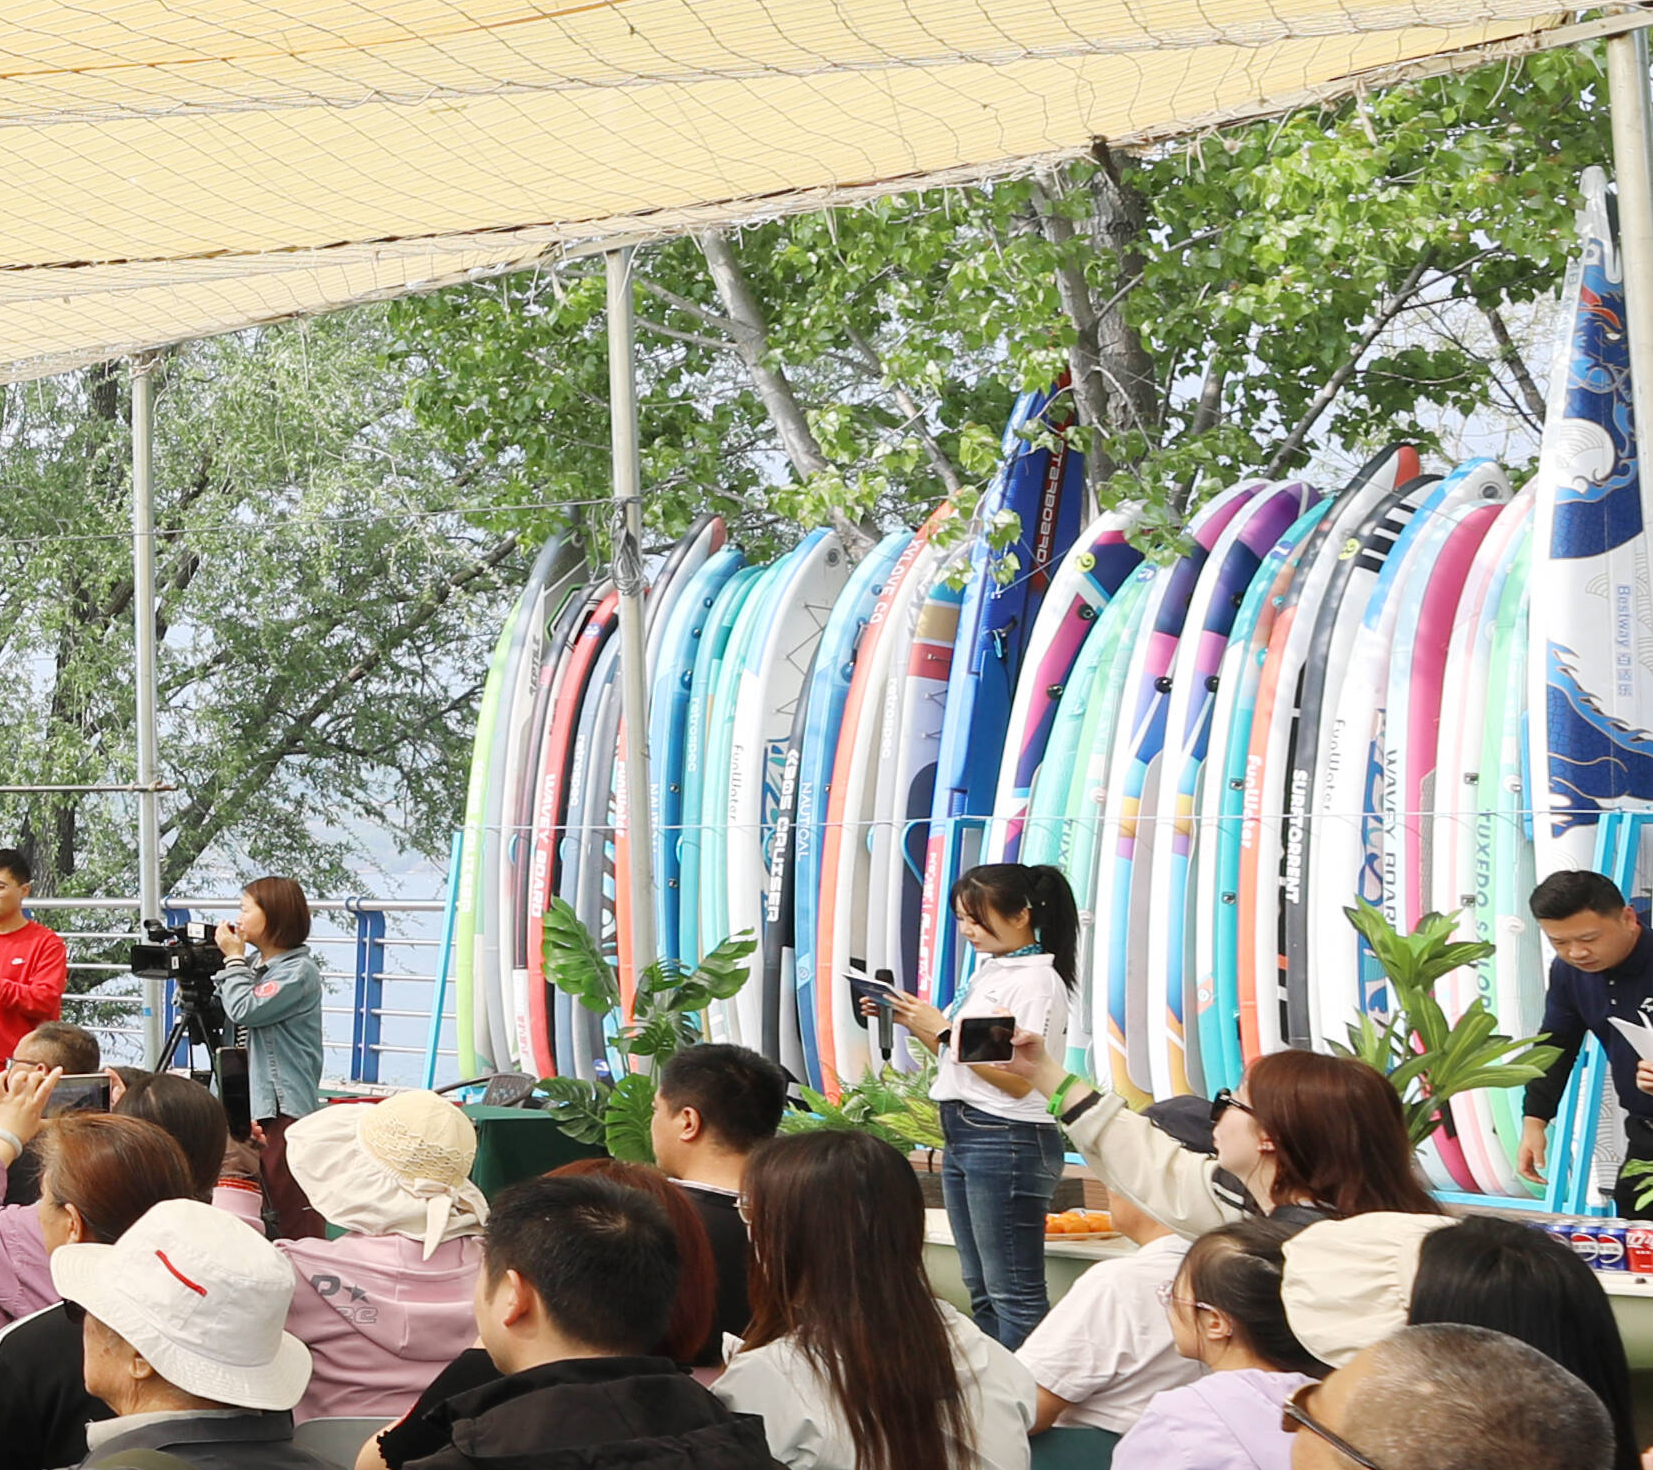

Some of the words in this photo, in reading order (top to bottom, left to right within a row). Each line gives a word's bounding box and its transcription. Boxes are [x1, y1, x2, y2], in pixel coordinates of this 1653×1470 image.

[1616, 585, 1632, 648] Bestway
[537, 773, 556, 845] WAVEY
[797, 782, 813, 861] NAUTICAL
[1284, 769, 1308, 904] SURFTORRENT
[531, 849, 549, 919] BOARD
